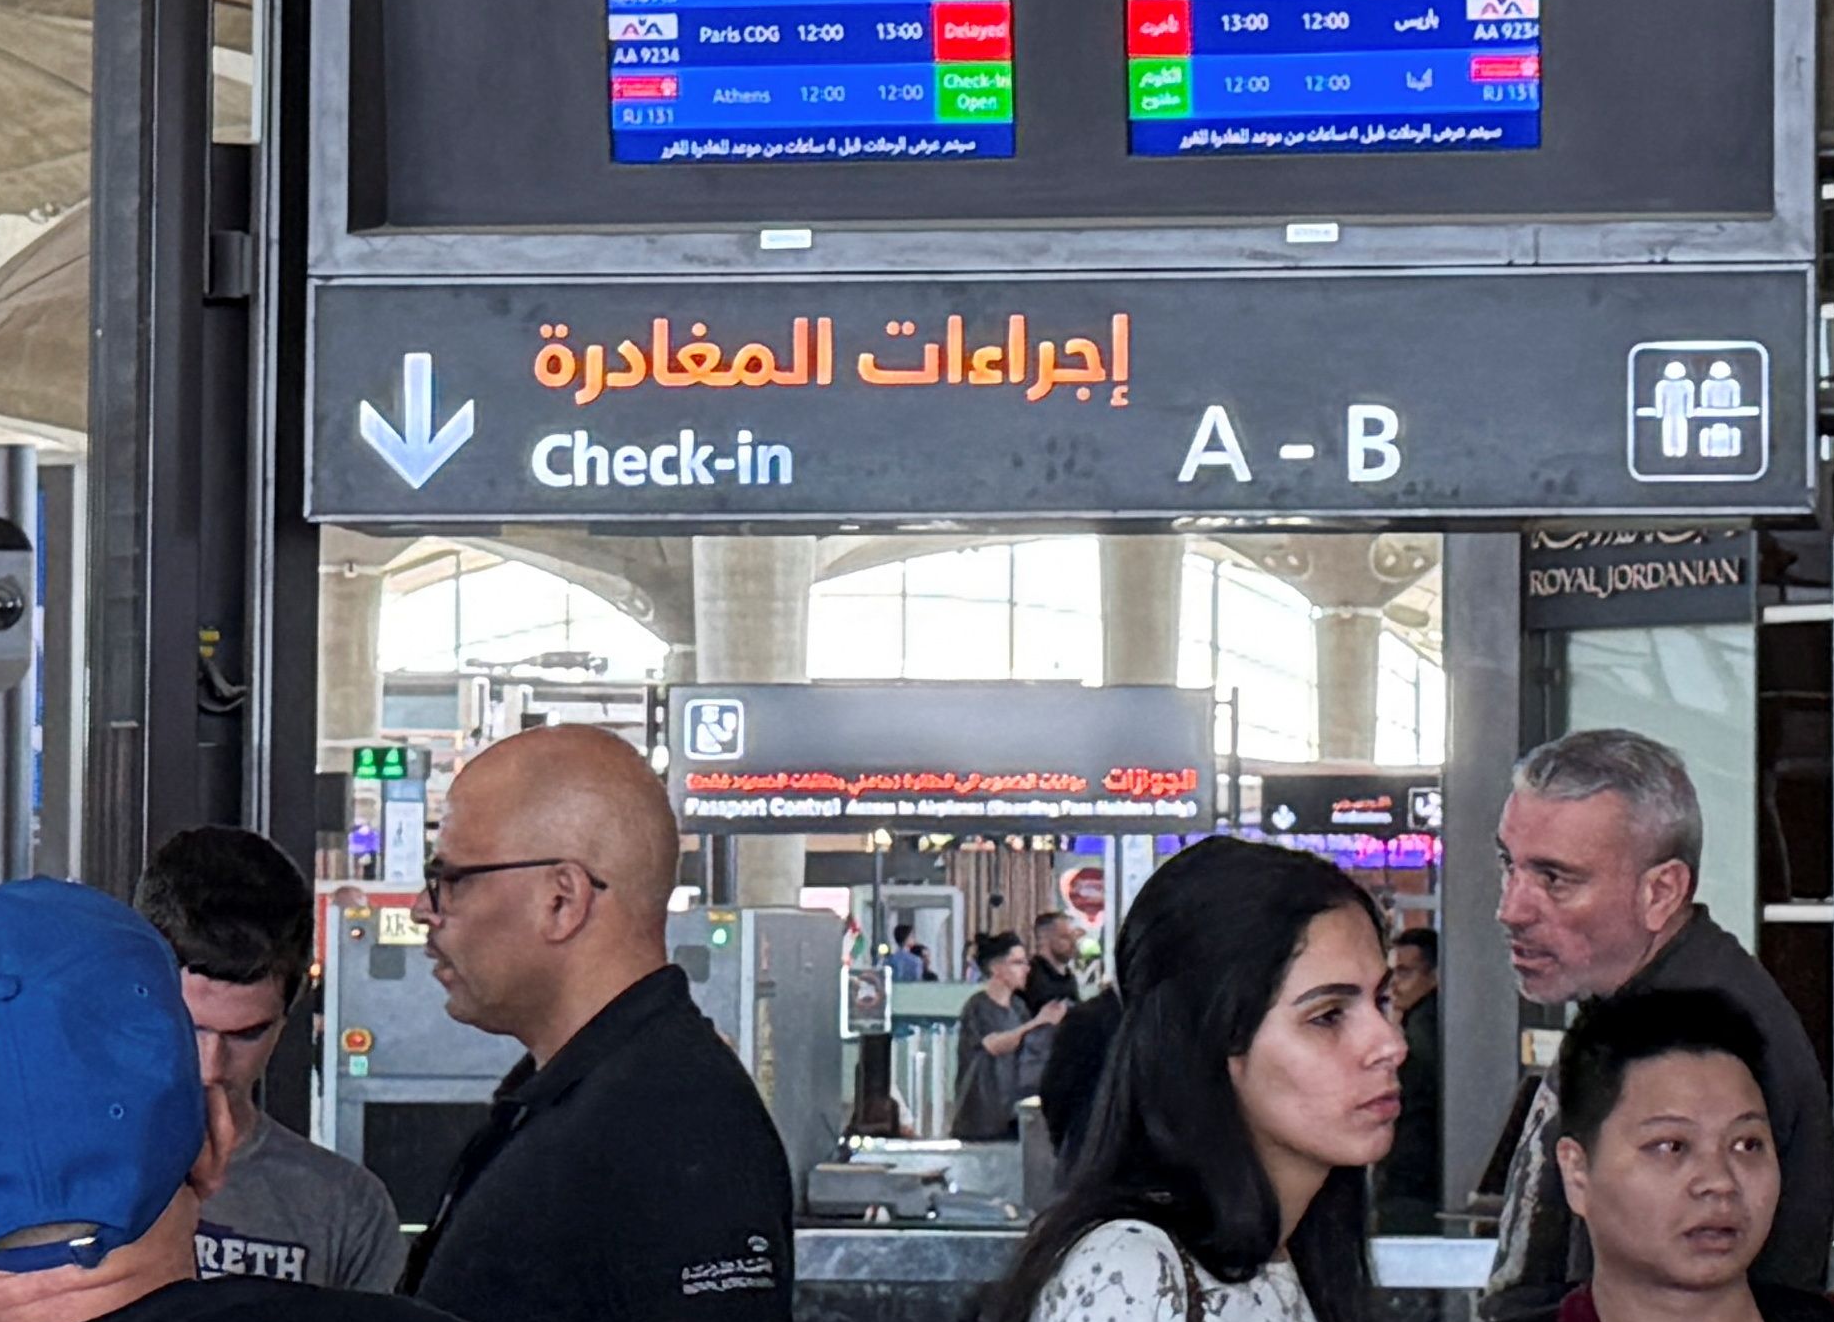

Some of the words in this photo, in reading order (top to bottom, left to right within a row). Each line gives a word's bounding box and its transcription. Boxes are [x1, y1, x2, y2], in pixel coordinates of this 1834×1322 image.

[699, 25, 742, 44] Paris
[743, 25, 781, 43] CDG
[797, 23, 845, 42] 12:00
[876, 21, 924, 40] 13:00
[713, 88, 771, 104] Athens
[800, 85, 846, 103] 12:00
[878, 84, 924, 101] 12:00
[533, 318, 831, 407] المغادرة
[858, 313, 1133, 407] إجراءات
[531, 429, 792, 488] Check-in
[1177, 404, 1253, 482] A
[1347, 404, 1401, 483] B
[1529, 565, 1603, 596] ROYAL
[1600, 558, 1740, 598] JORDANIAN
[684, 797, 767, 819] Passport
[769, 797, 842, 817] Control
